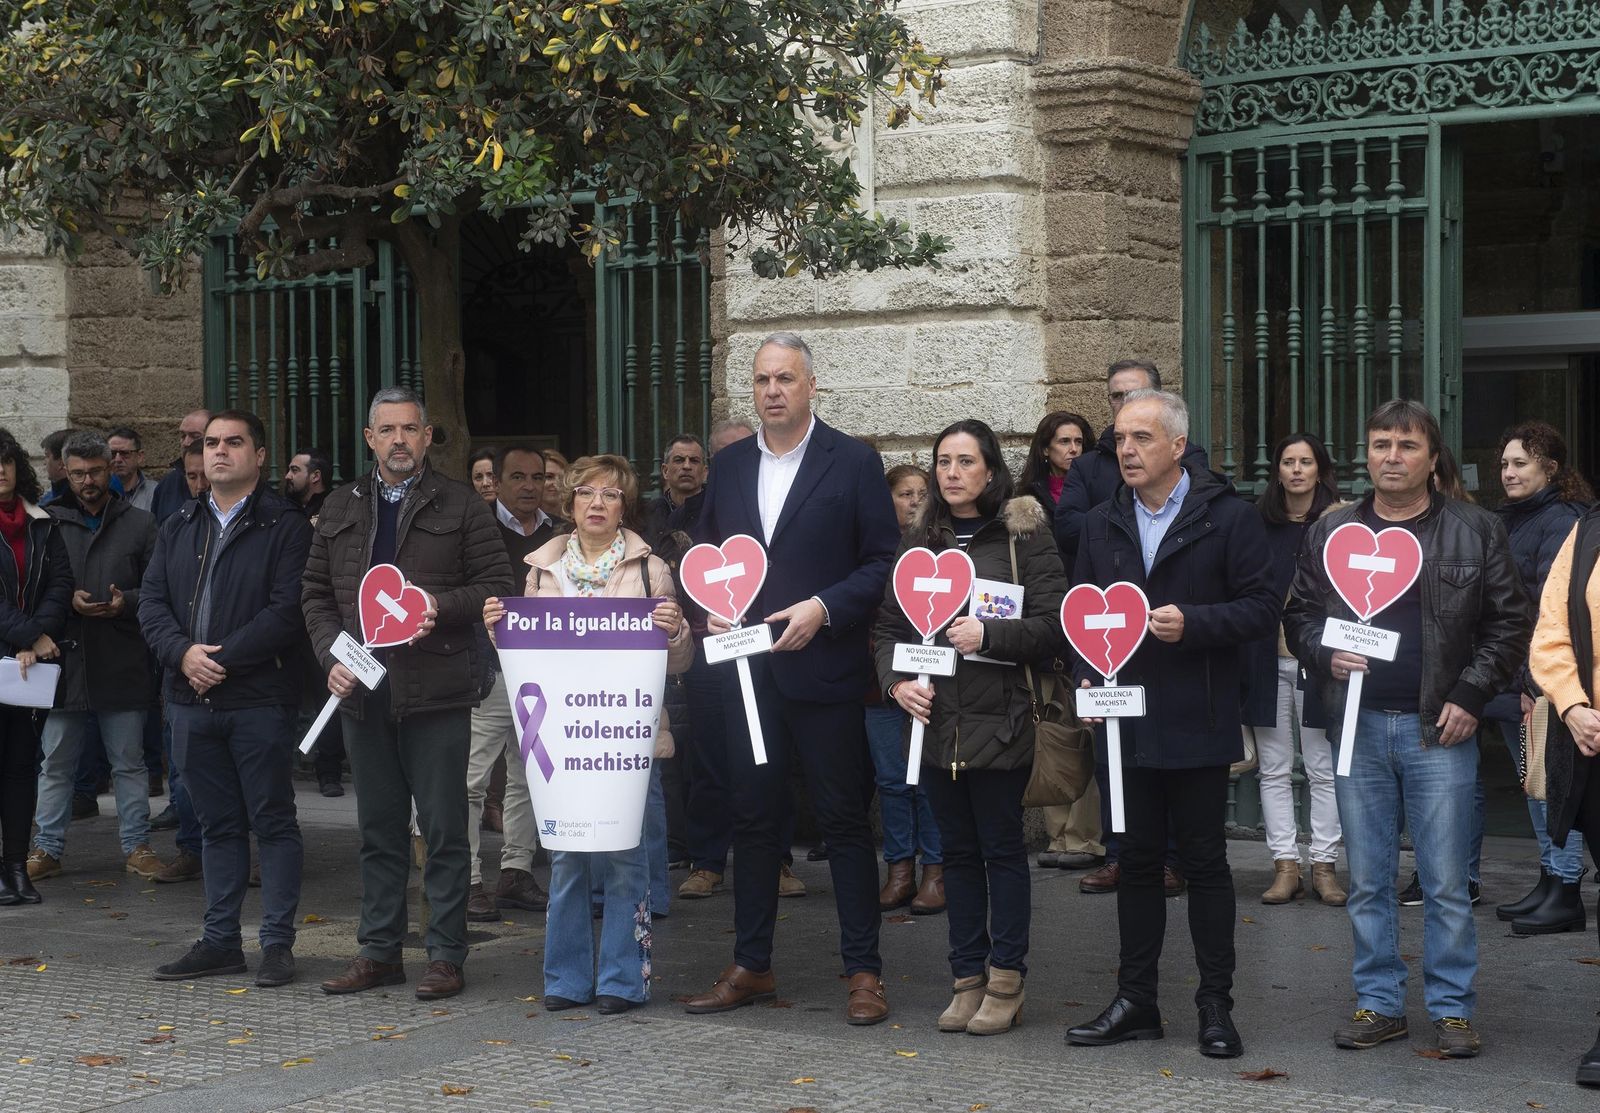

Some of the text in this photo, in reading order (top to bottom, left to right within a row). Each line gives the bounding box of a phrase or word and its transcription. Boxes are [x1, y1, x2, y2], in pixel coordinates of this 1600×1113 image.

[507, 611, 653, 637] Por la igualdad
[1339, 623, 1388, 640] NO VIOLENCIA
[716, 628, 760, 644] NO VIOLENCIA
[723, 638, 756, 650] MACHISTA
[1343, 634, 1379, 647] MACHISTA
[345, 641, 377, 672] NO VIOLENCIA
[910, 656, 940, 664] MACHISTA
[915, 648, 946, 656] VIOLENCIA
[345, 651, 369, 674] MACHISTA
[564, 688, 653, 708] contra la
[1098, 690, 1133, 698] VIOLENCIA
[564, 719, 652, 739] violencia
[564, 752, 650, 771] machista
[558, 820, 592, 829] Diputación
